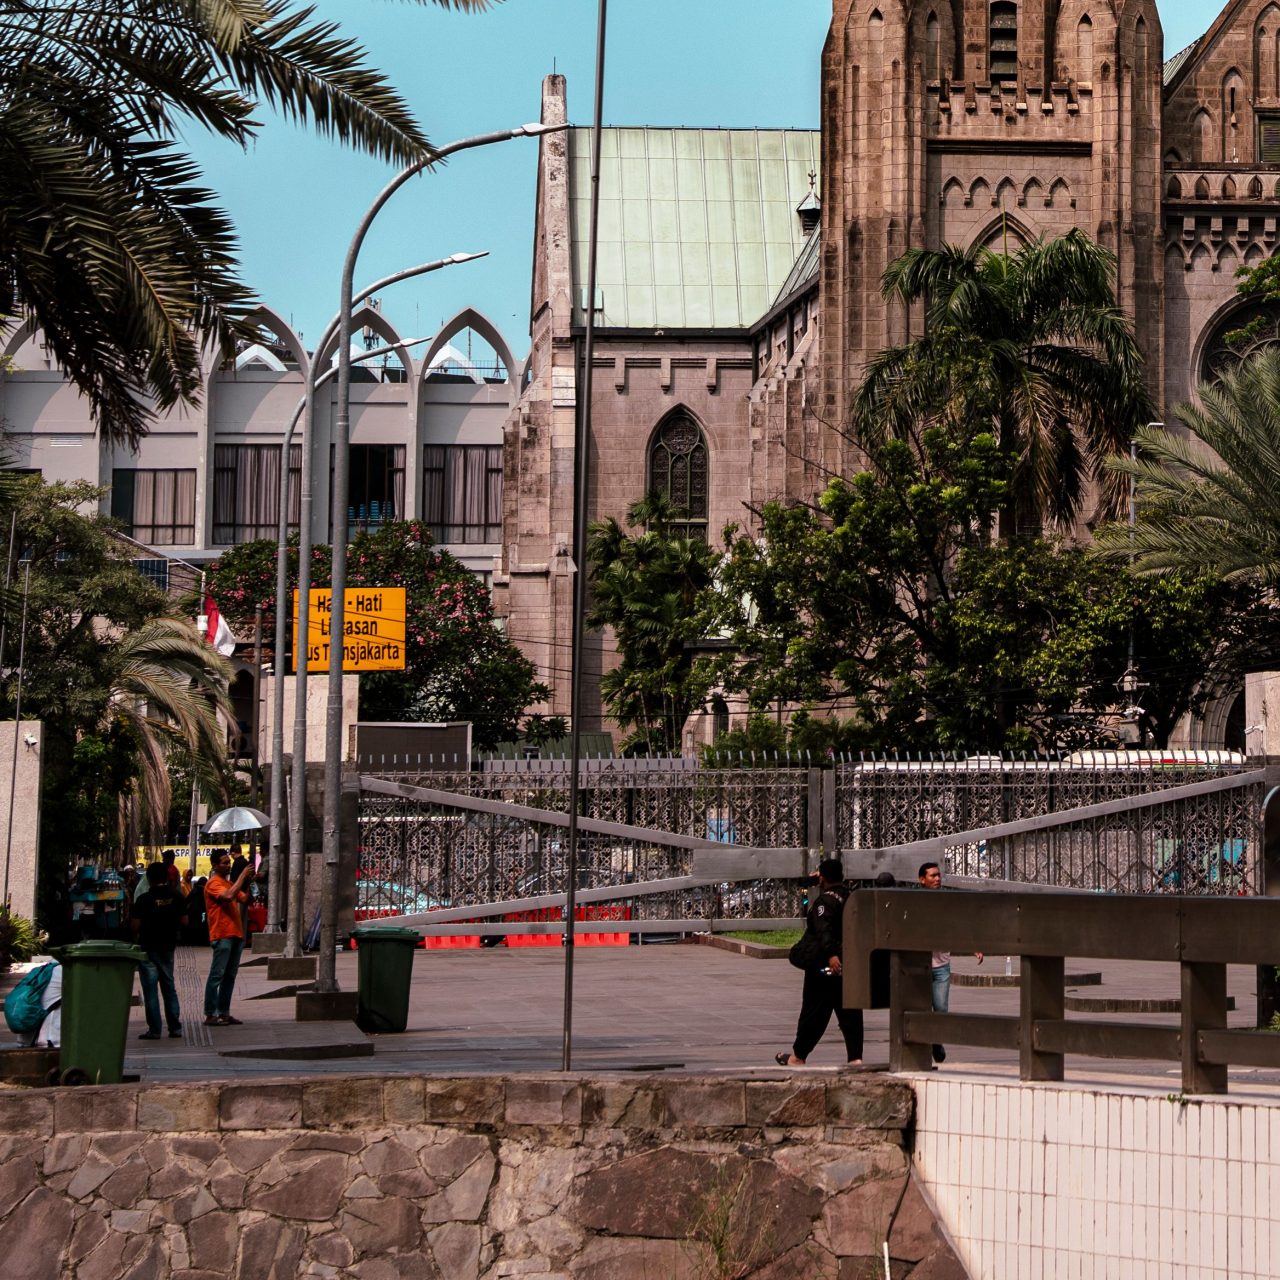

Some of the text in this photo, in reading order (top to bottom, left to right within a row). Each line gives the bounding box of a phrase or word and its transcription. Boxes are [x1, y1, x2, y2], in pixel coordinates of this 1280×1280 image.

[356, 593, 383, 612] Hati
[321, 618, 378, 636] Liasan
[307, 642, 400, 666] us Tnsjakarta
